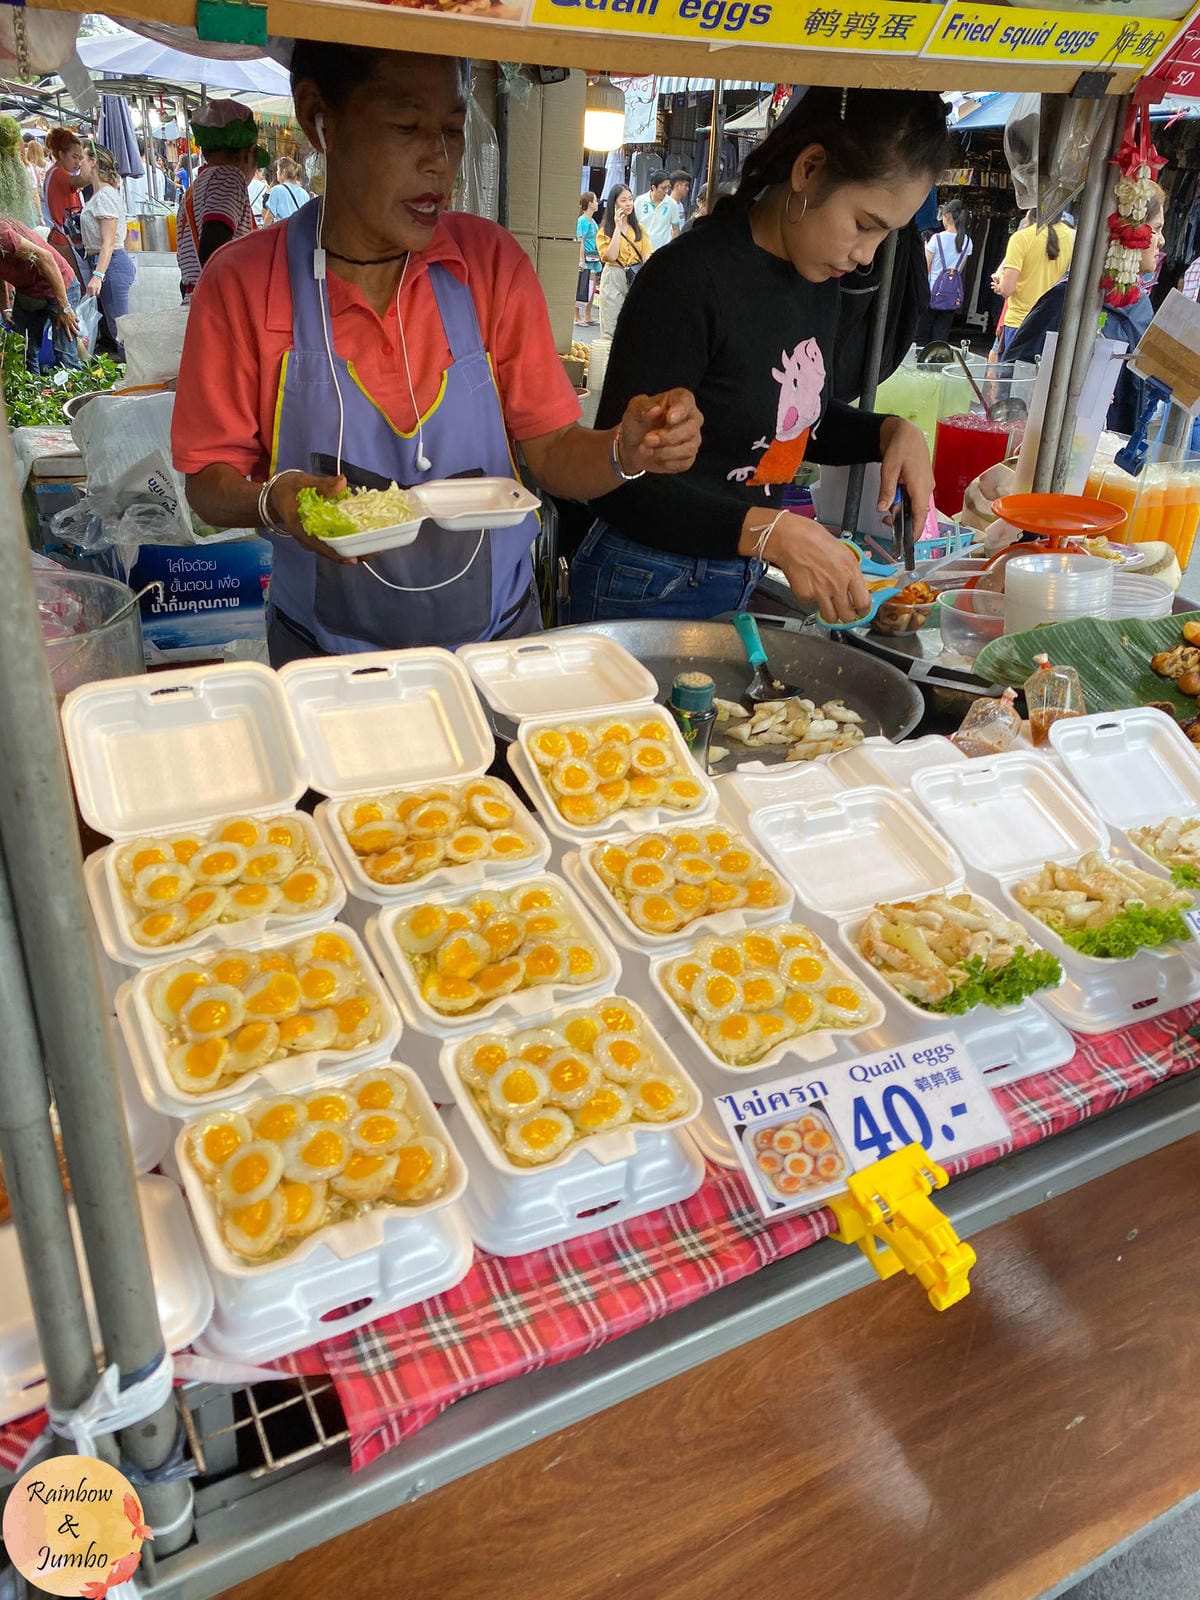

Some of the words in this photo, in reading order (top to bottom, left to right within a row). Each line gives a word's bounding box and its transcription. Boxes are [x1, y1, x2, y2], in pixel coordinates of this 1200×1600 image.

[549, 0, 659, 15] uail
[678, 0, 773, 32] eggs
[803, 7, 917, 41] 鹌鹑蛋
[942, 13, 1000, 42] Fried
[999, 21, 1057, 52] squid
[1054, 27, 1100, 55] eggs
[1172, 70, 1195, 87] 50
[166, 557, 217, 573] ใส่ใจด้วย
[170, 577, 213, 593] ขั้นตอน
[218, 573, 241, 589] เพื่อ
[849, 1053, 907, 1083] Quail
[912, 1043, 956, 1067] eggs
[914, 1066, 964, 1093] 鹌鹑蛋
[719, 1080, 829, 1121] ไข่ครก
